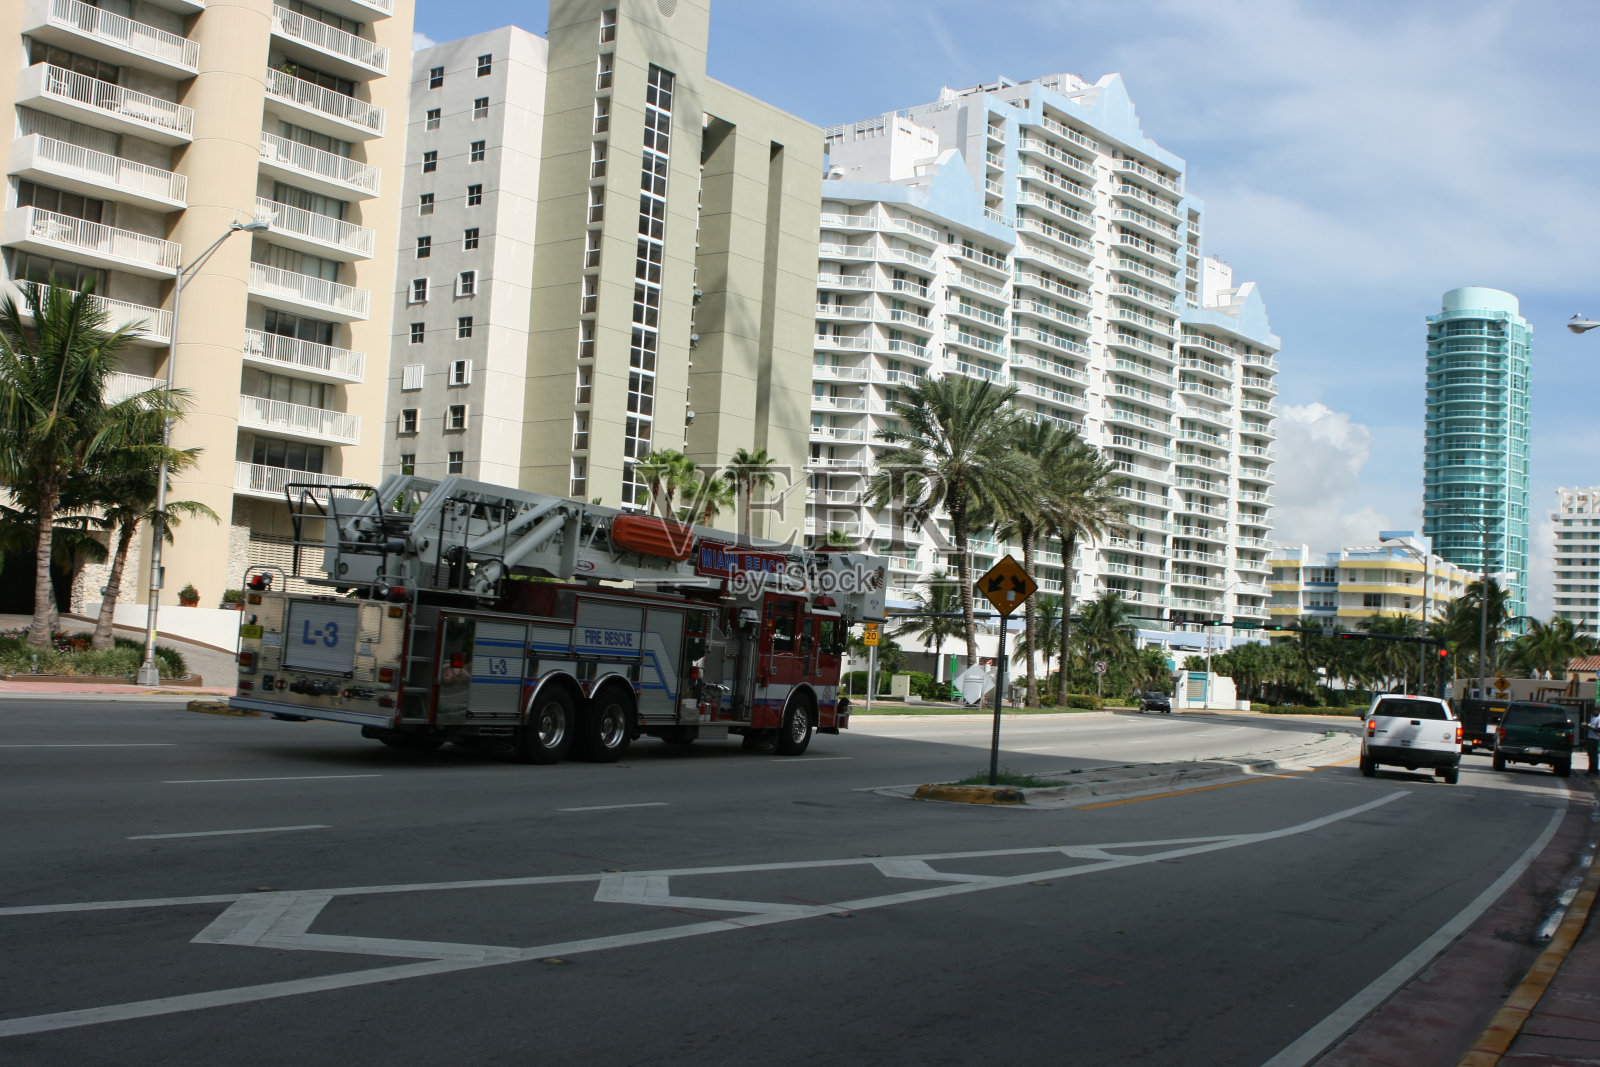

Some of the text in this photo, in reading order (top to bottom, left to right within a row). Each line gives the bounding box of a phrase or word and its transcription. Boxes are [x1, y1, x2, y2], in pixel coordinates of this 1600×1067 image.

[701, 547, 785, 574] MIAMI BEACH
[303, 619, 339, 648] L-3
[585, 629, 633, 647] FIRE RESCUE
[866, 632, 877, 640] 20
[489, 657, 507, 675] L-3
